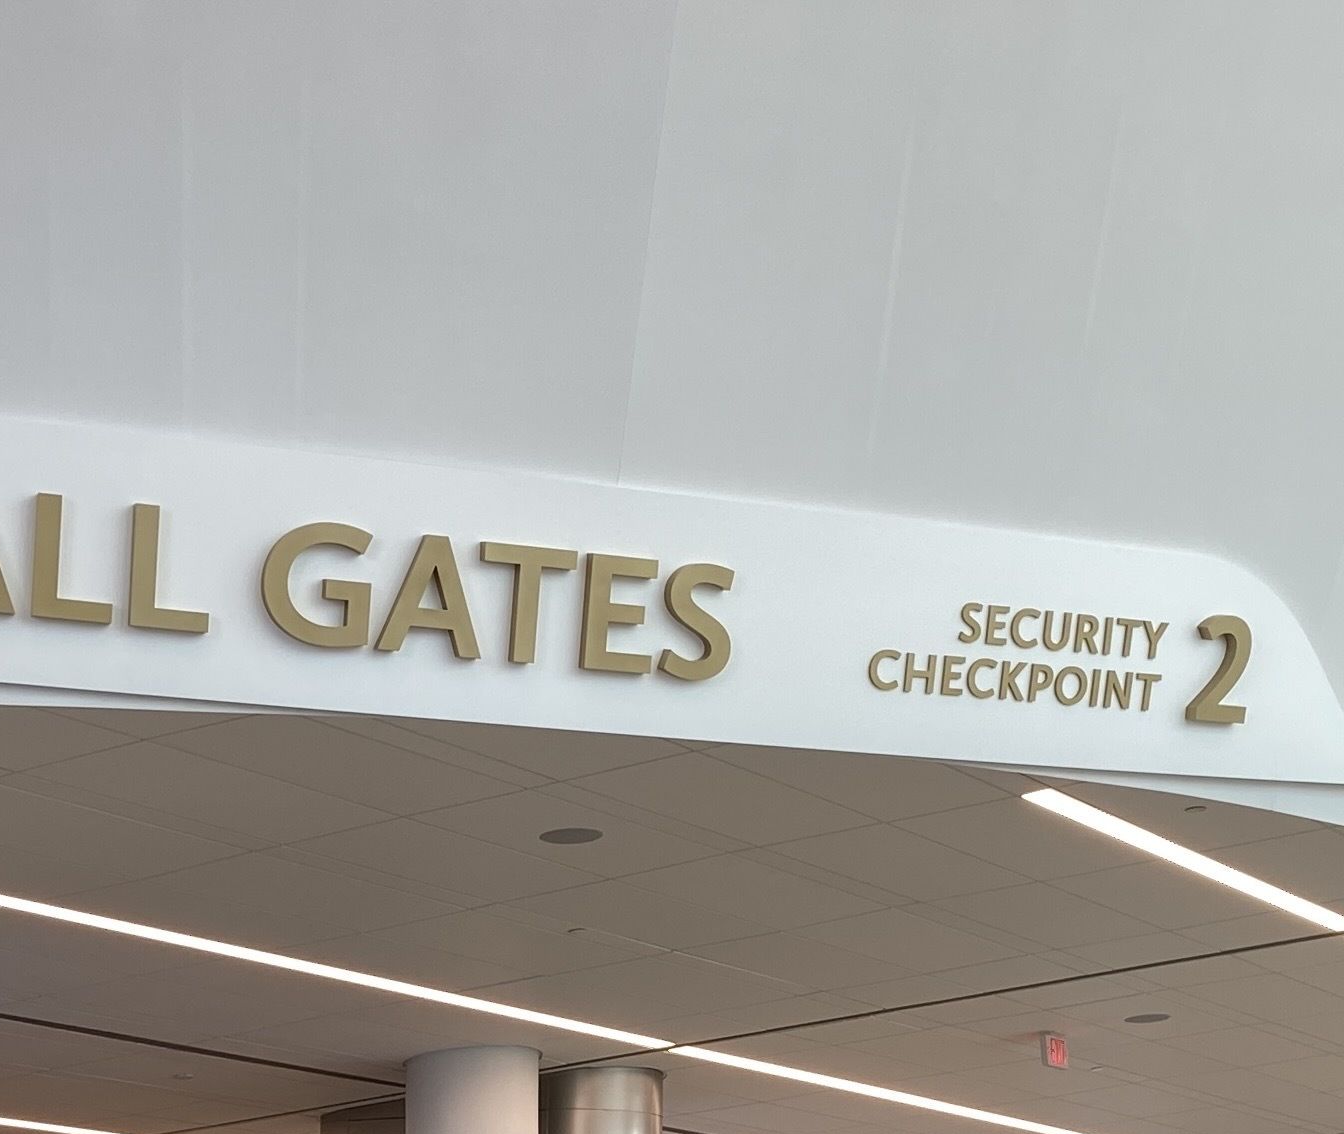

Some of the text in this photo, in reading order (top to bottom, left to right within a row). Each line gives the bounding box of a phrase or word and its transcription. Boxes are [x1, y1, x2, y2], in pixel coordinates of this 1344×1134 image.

[261, 521, 735, 682] GATES
[958, 602, 1170, 660] SECURITY
[868, 649, 1162, 711] CHECKPOINT
[1184, 614, 1253, 725] 2
